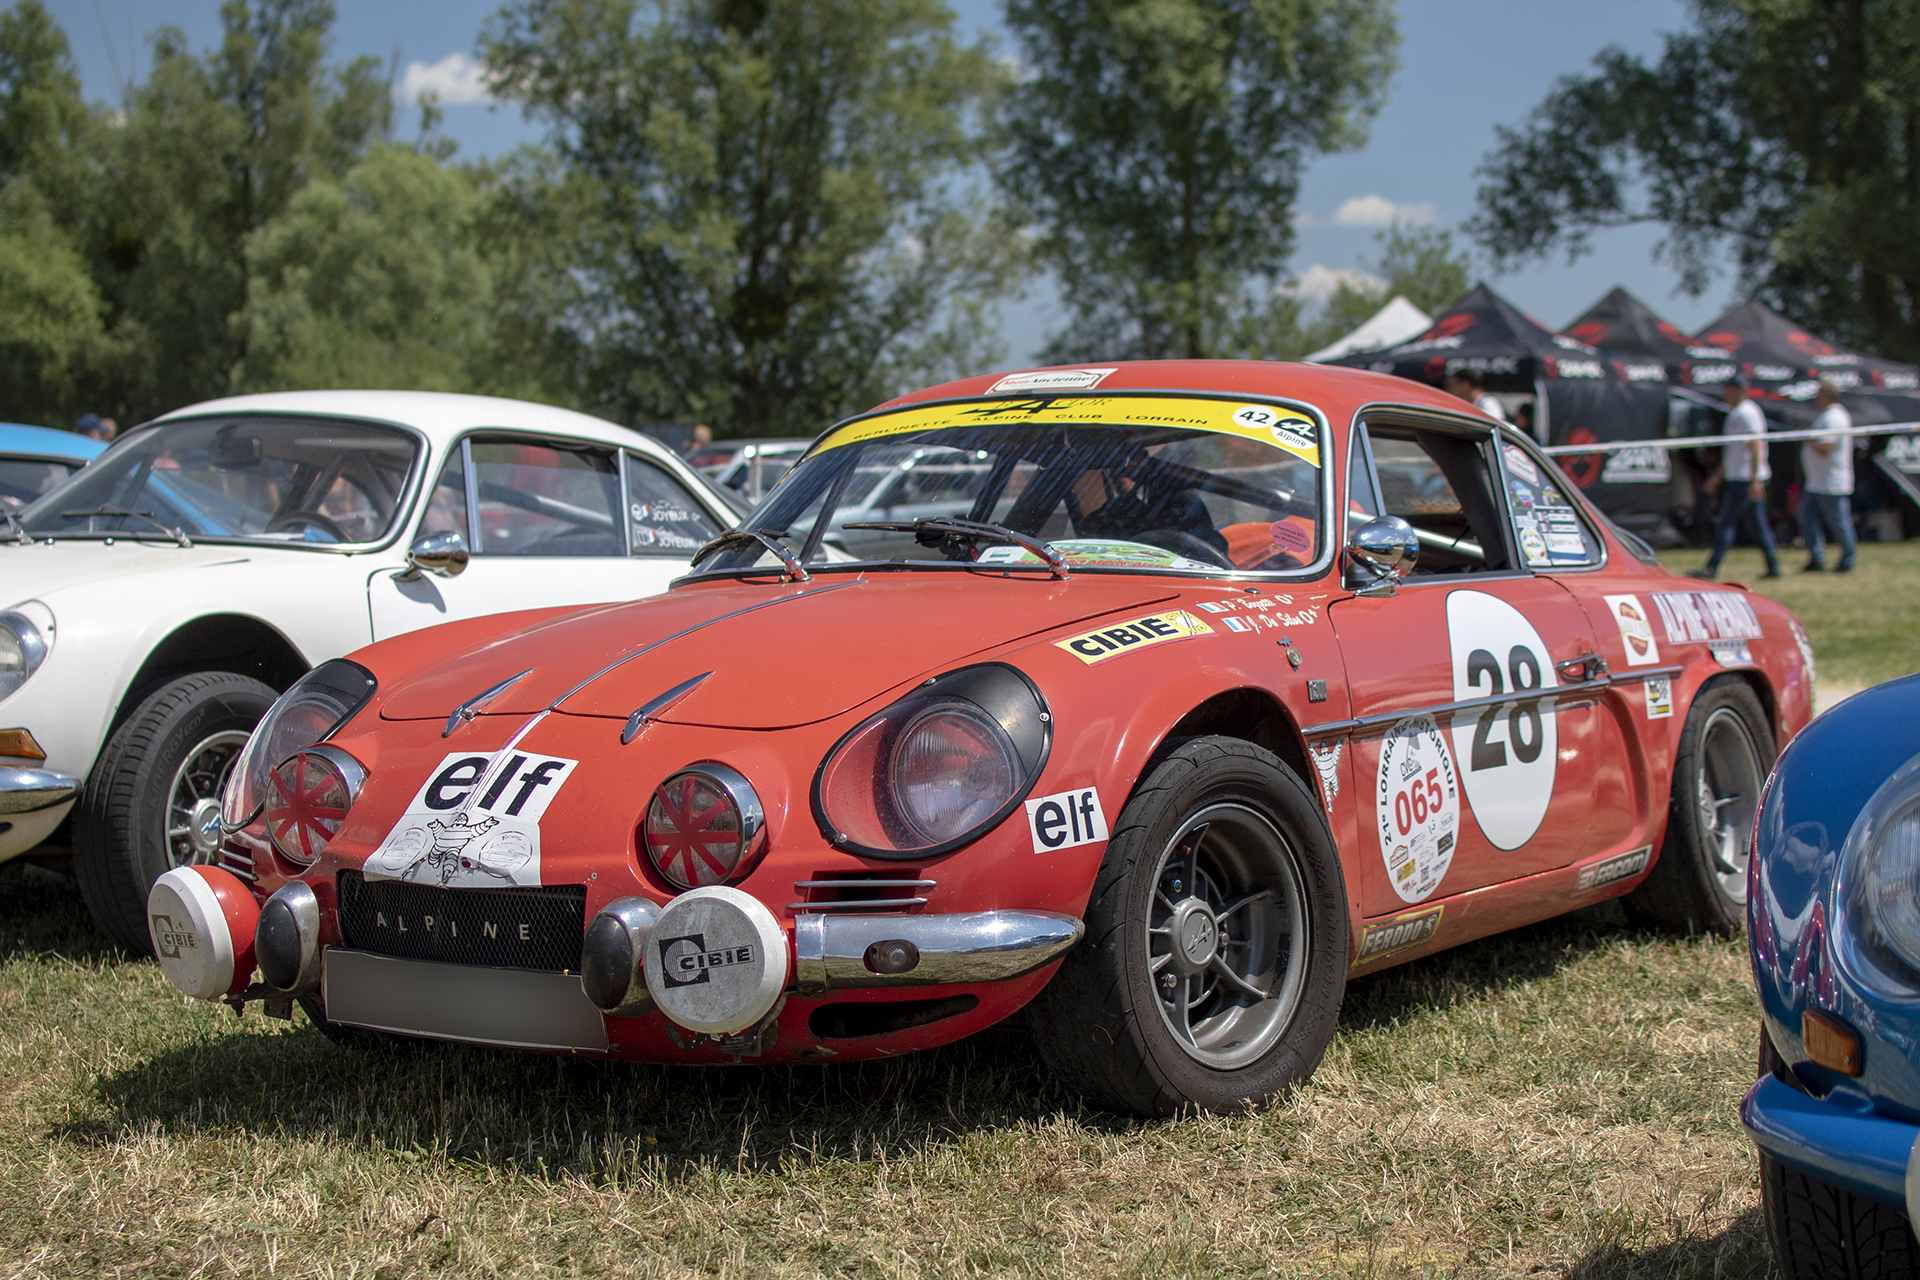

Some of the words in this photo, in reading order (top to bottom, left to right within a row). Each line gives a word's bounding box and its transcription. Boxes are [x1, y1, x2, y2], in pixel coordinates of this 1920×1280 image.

[853, 419, 951, 440] BERLINETTE
[971, 414, 1033, 422] ALPINE
[1125, 414, 1208, 425] LORRAIN
[1239, 410, 1270, 425] 42
[1276, 430, 1307, 448] Alpine
[652, 510, 688, 522] JOYEUX
[658, 537, 694, 549] JOYEUX
[1221, 600, 1242, 611] P.
[1258, 613, 1279, 628] Da
[1276, 612, 1304, 627] Silva
[1467, 645, 1543, 772] 28
[1380, 719, 1410, 807] LORRAINE
[1409, 717, 1456, 800] HISTORIQUE
[424, 754, 567, 817] elf
[1395, 766, 1443, 837] 065
[1034, 791, 1095, 849] elf
[1594, 853, 1645, 885] FACOM
[376, 911, 530, 941] ALPINE
[1361, 919, 1424, 956] FERODO
[163, 933, 195, 947] CIBIE
[680, 947, 751, 970] CIBIE
